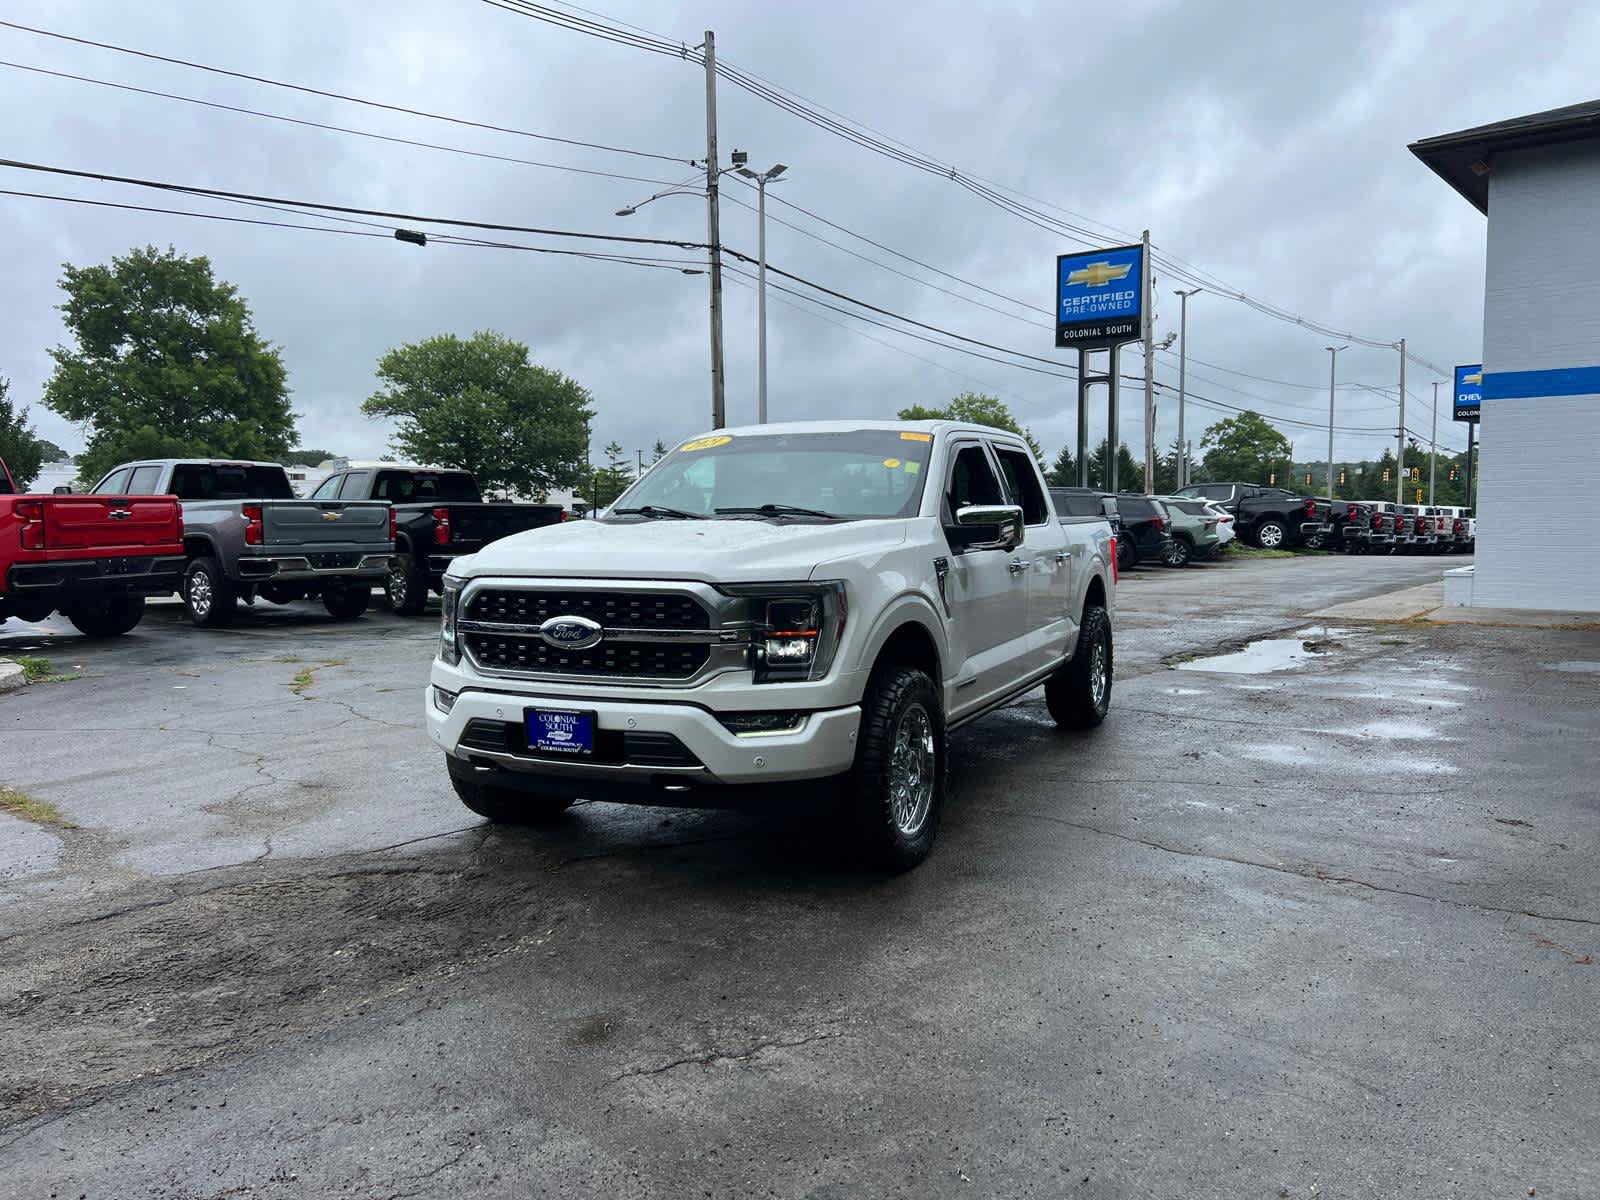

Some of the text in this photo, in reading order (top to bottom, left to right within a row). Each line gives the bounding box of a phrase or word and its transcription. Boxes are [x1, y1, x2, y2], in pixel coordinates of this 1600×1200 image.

[1063, 291, 1135, 306] CERTIFIED
[1065, 301, 1131, 315] PRE-OWNED
[1064, 324, 1132, 339] COLONIAL SOUTH
[553, 624, 582, 639] Ford
[539, 714, 578, 724] COLONIAL
[545, 722, 573, 732] SOUTH
